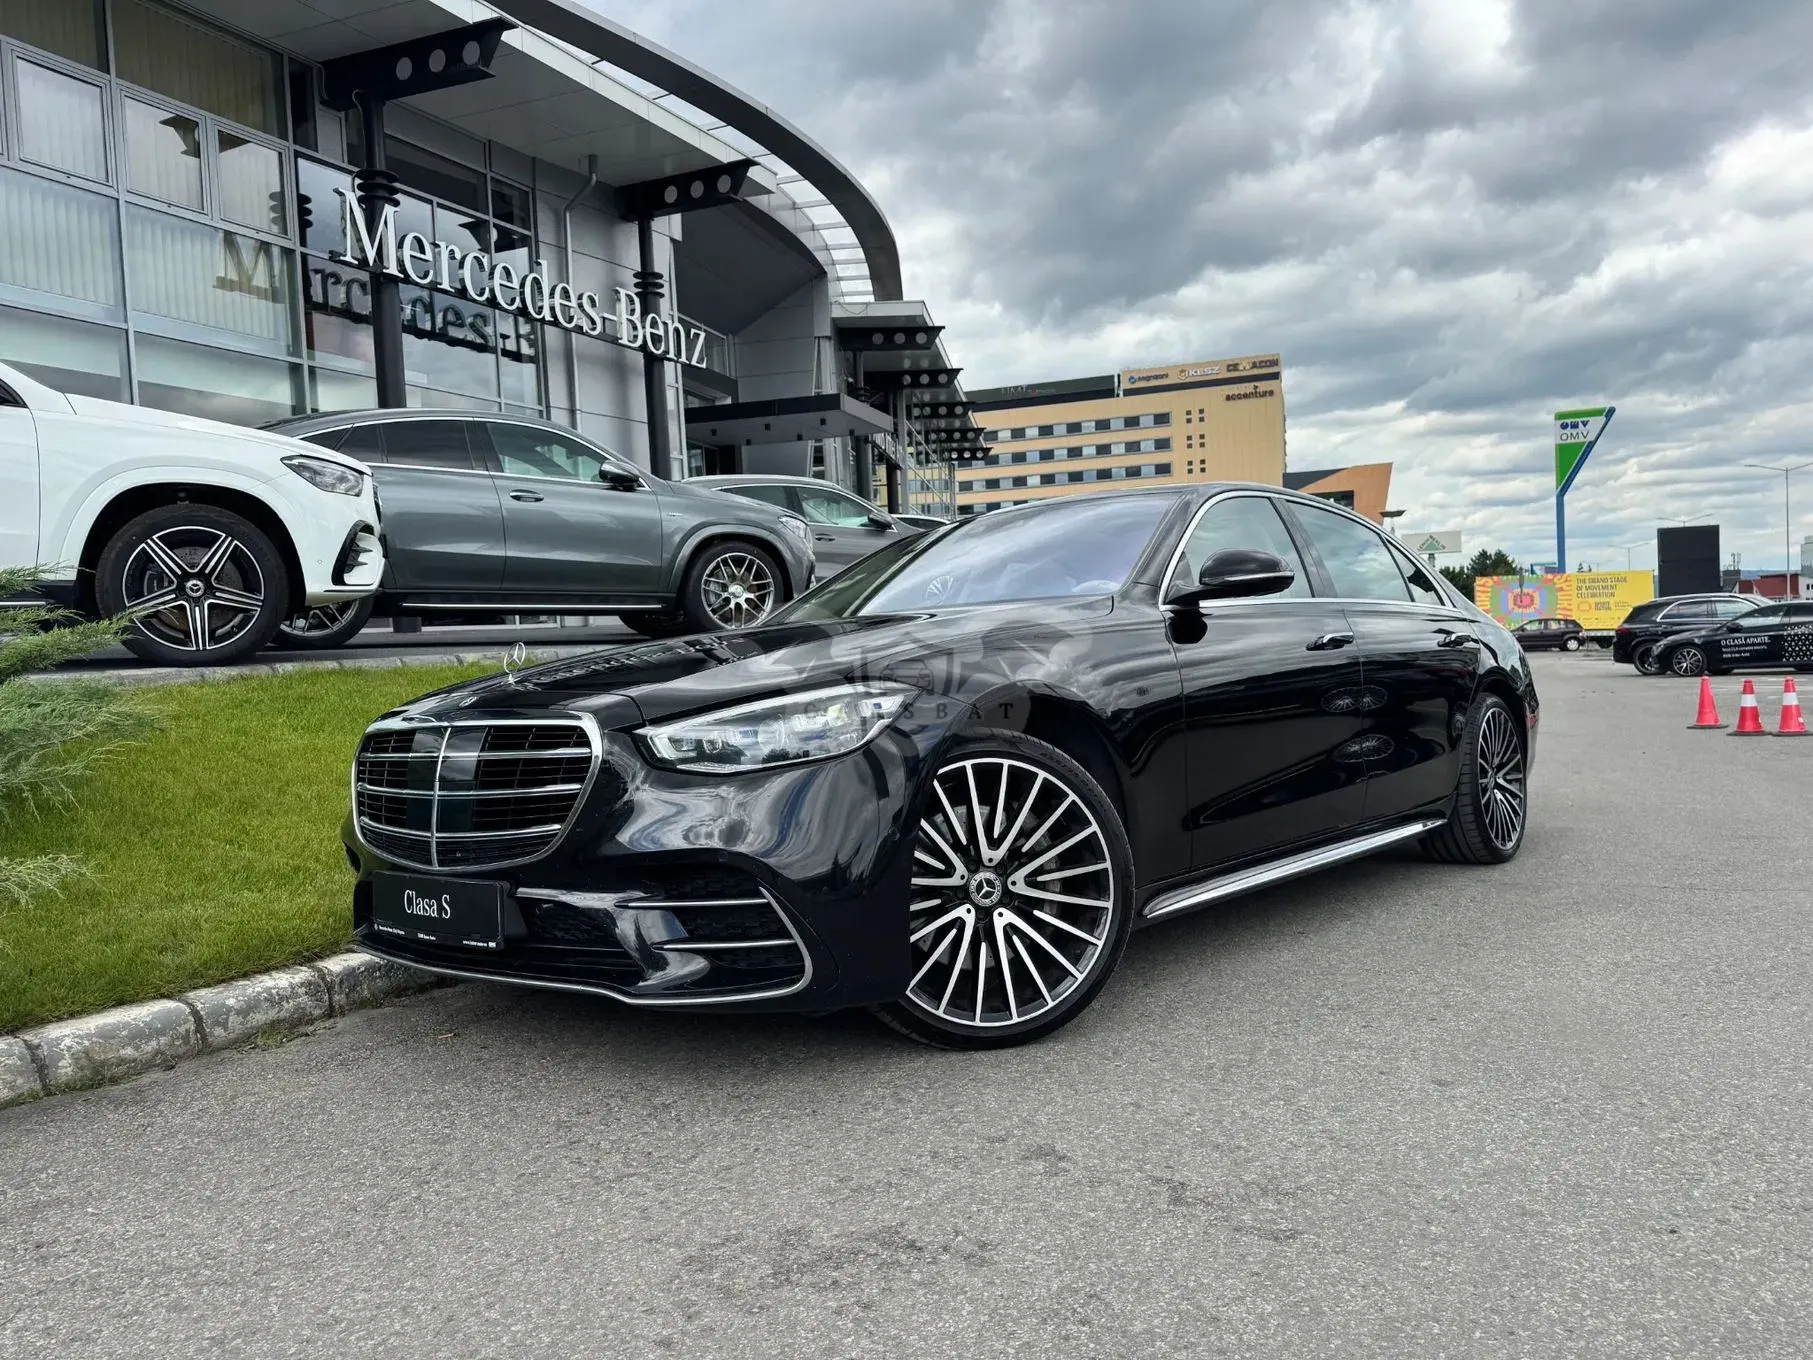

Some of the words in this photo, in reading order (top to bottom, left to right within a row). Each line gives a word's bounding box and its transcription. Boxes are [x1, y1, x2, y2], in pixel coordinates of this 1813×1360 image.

[333, 187, 708, 369] Mercedes-Benz
[1225, 384, 1275, 402] accenture
[1560, 430, 1590, 441] OMV
[1584, 583, 1618, 592] MOVEMENT
[1576, 591, 1616, 599] CELEBRATION
[404, 889, 439, 918] Clasa
[441, 894, 451, 919] S
